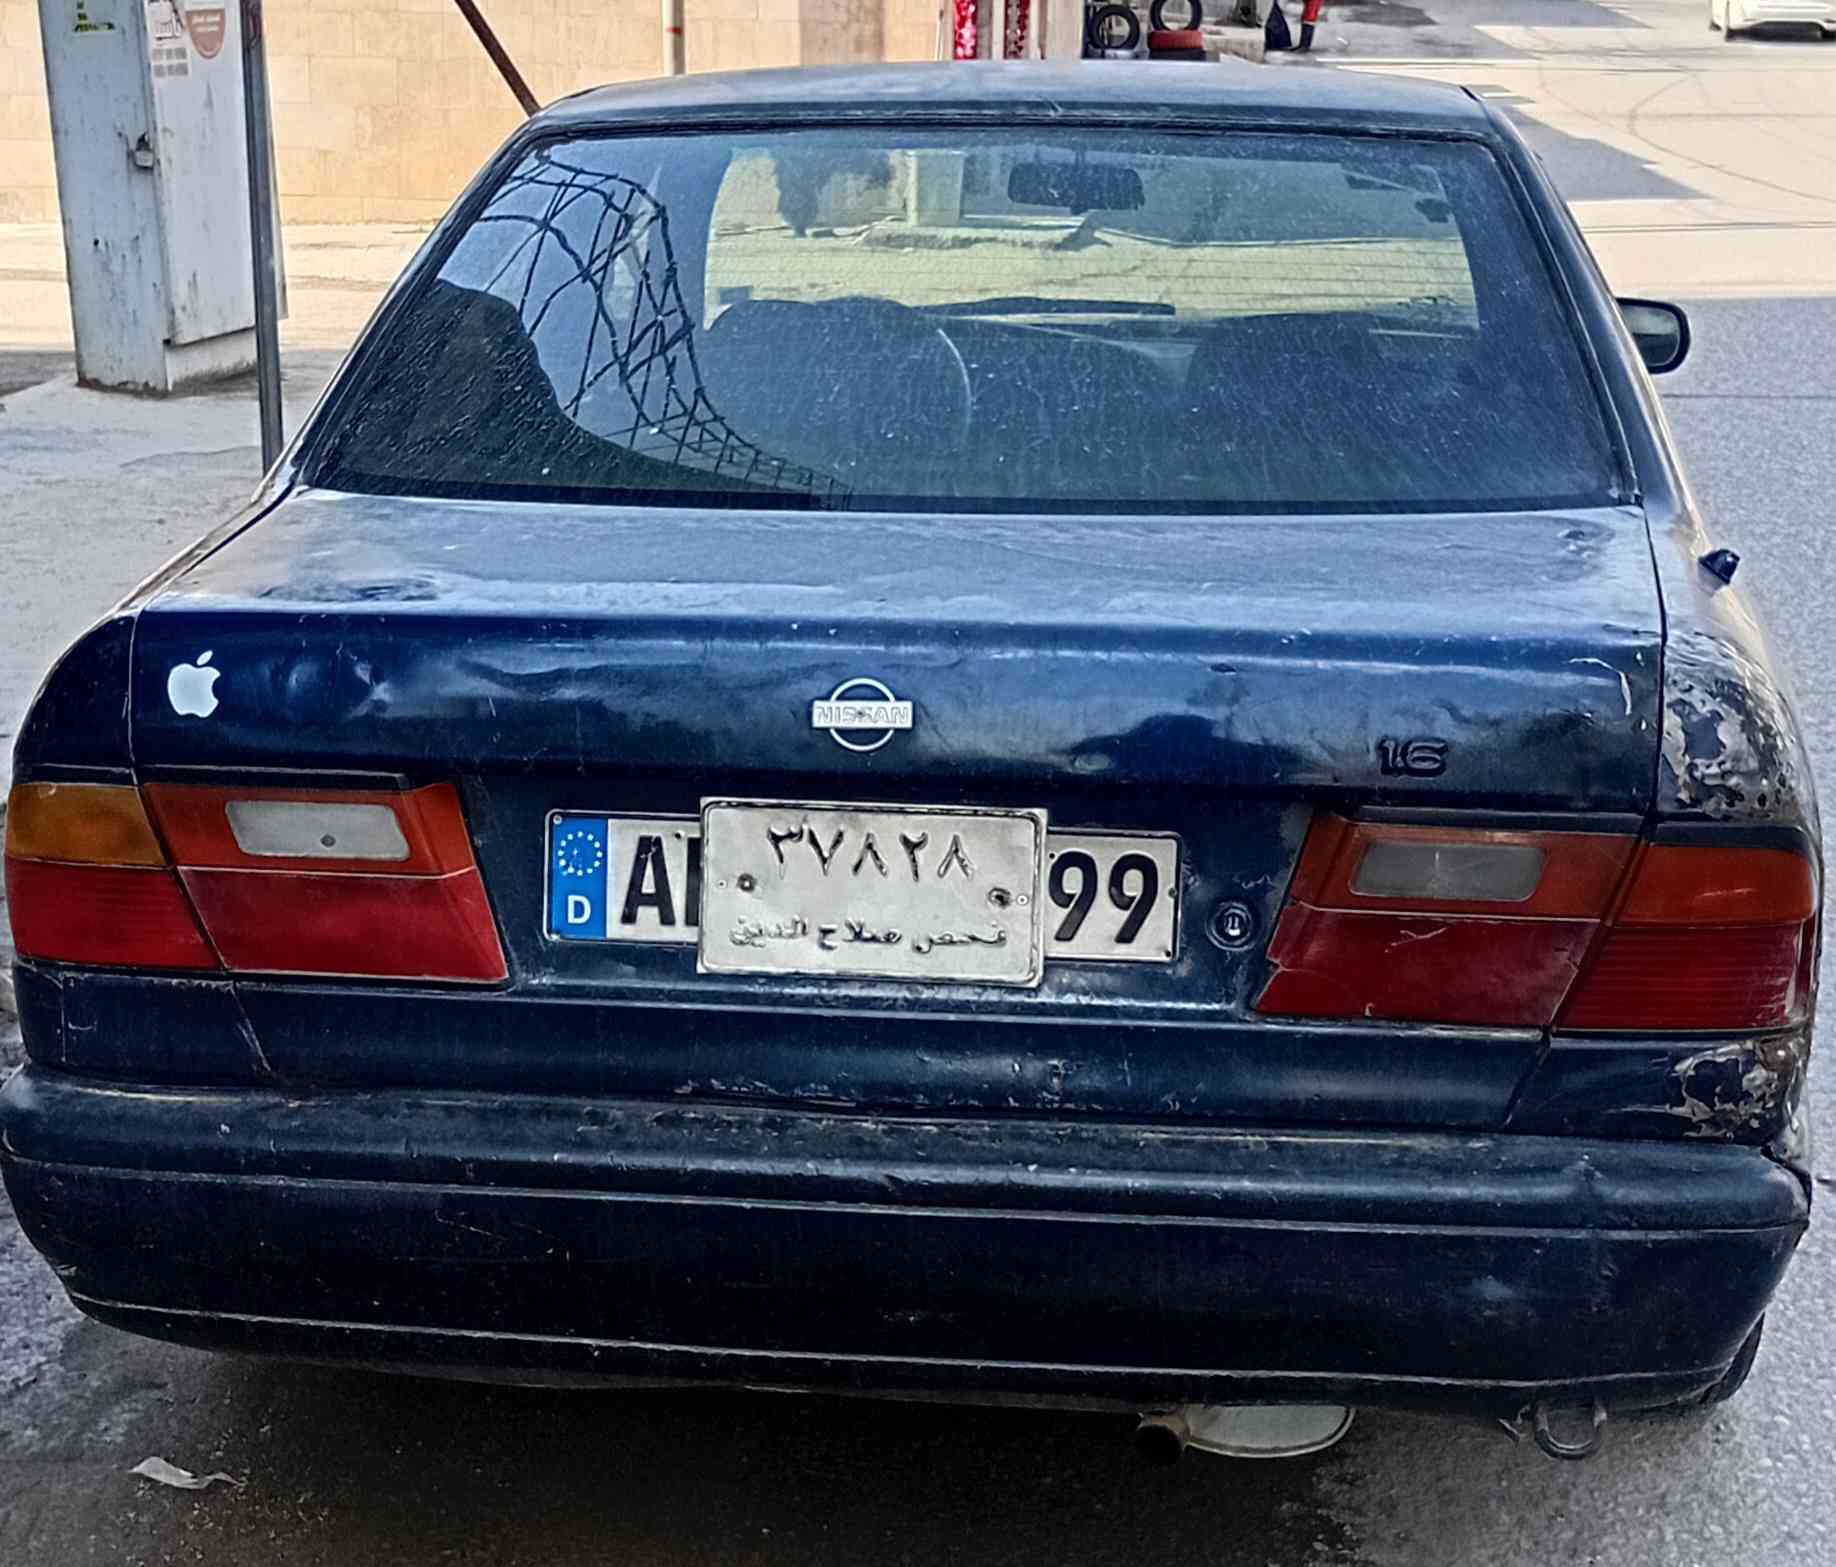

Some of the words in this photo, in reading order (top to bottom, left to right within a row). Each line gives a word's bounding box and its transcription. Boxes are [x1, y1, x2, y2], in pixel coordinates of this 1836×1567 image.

[815, 705, 909, 726] NISSAN
[767, 823, 977, 881] ٣٧٨٢٨
[567, 895, 592, 924] D
[1048, 850, 1158, 943] 99
[816, 916, 903, 950] صلاح
